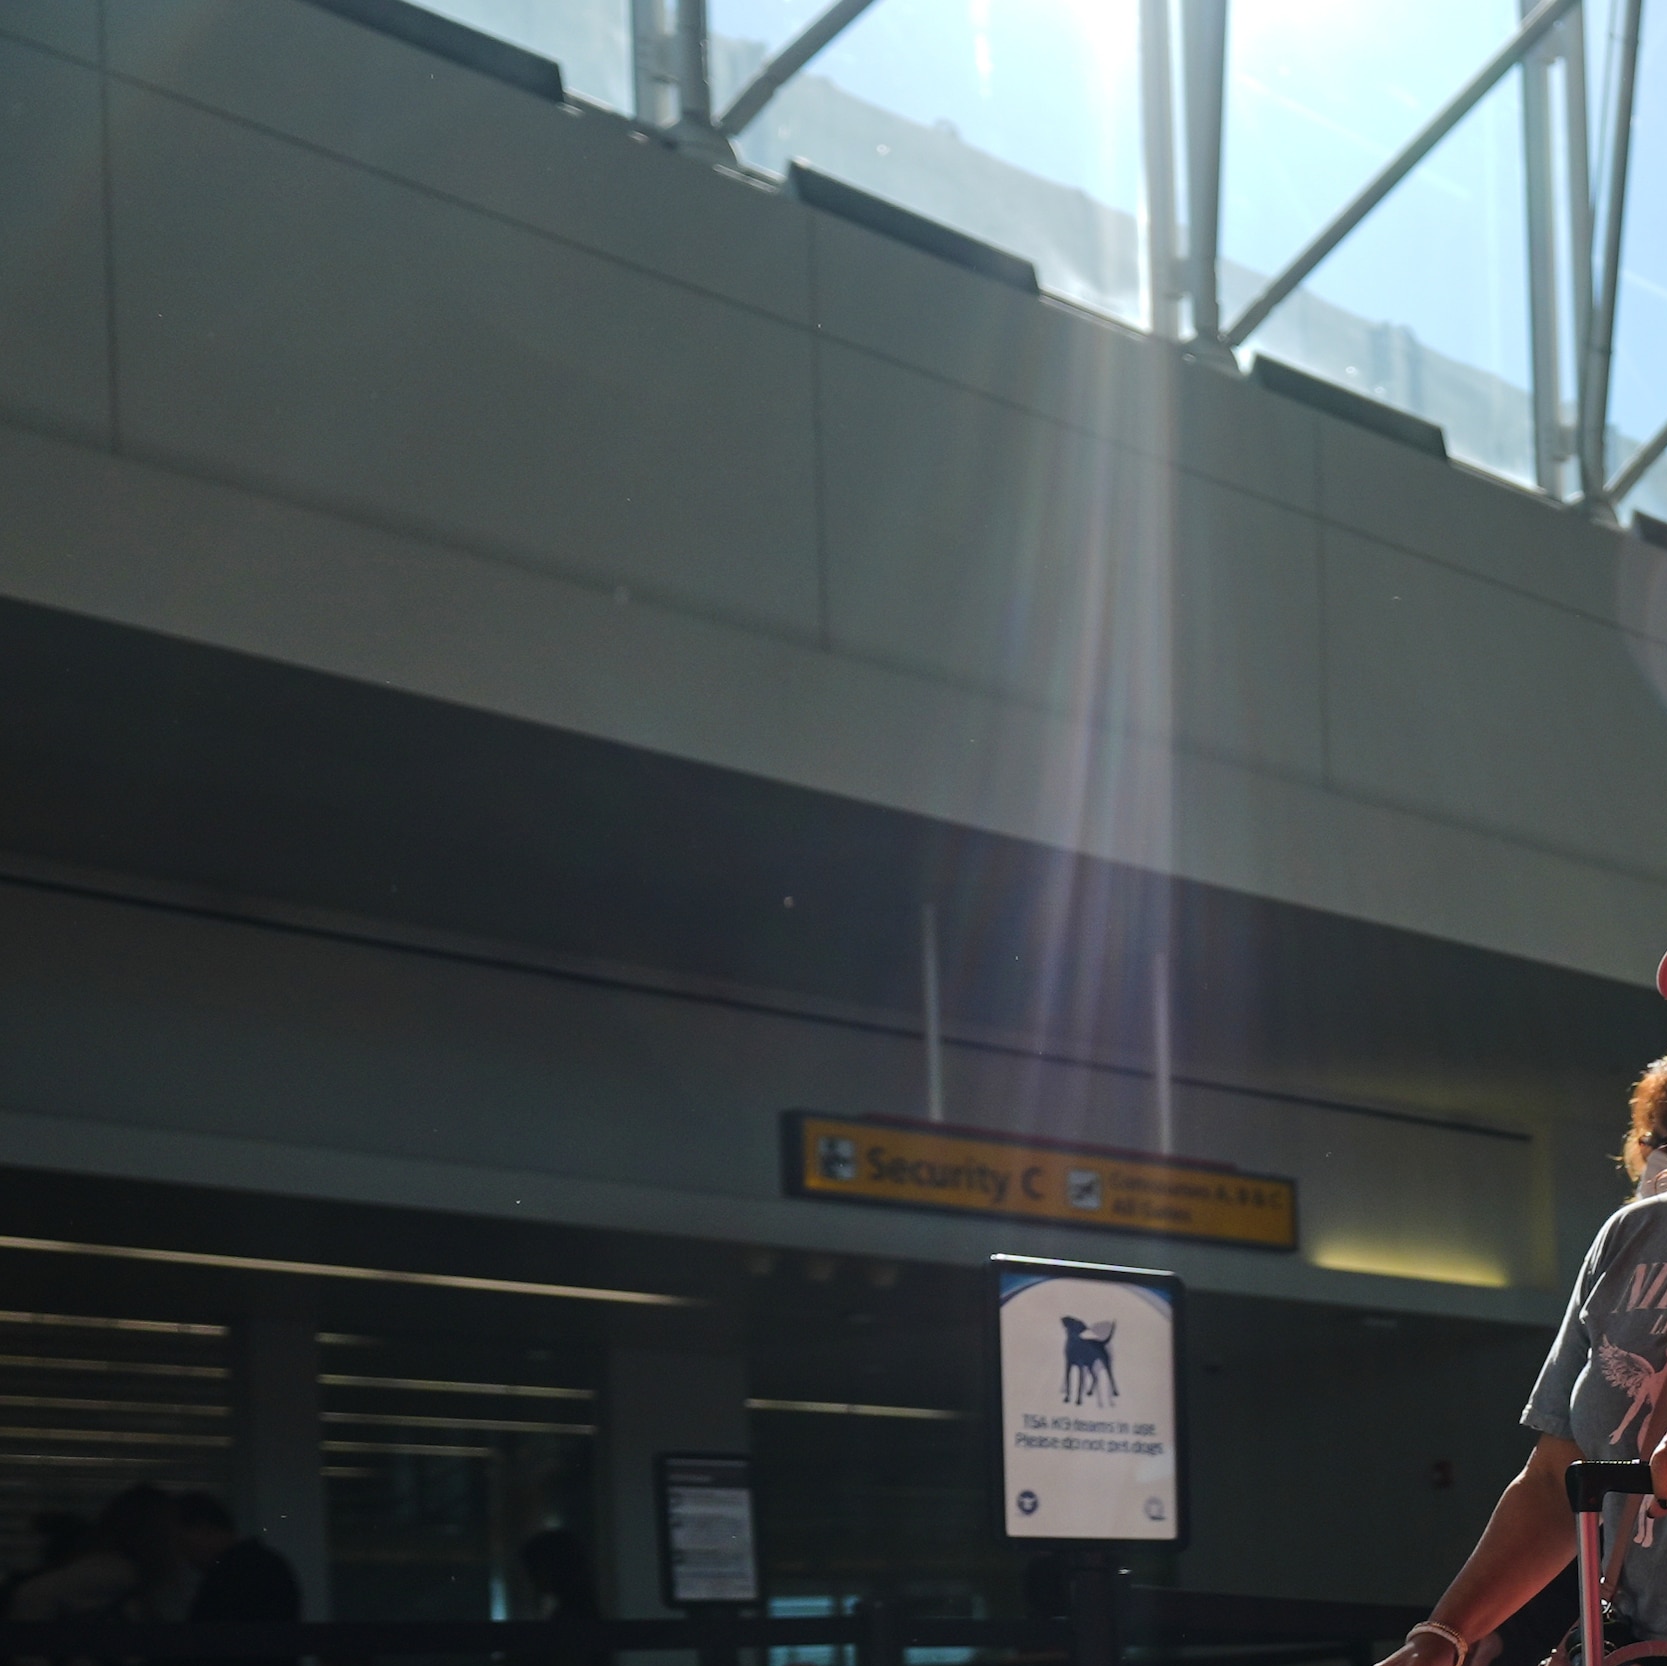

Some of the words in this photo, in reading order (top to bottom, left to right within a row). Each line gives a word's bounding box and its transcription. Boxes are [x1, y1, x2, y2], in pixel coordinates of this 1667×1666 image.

[867, 1145, 1007, 1207] Security
[1021, 1167, 1045, 1201] C
[1015, 1432, 1059, 1449] Please
[1082, 1438, 1104, 1451] not
